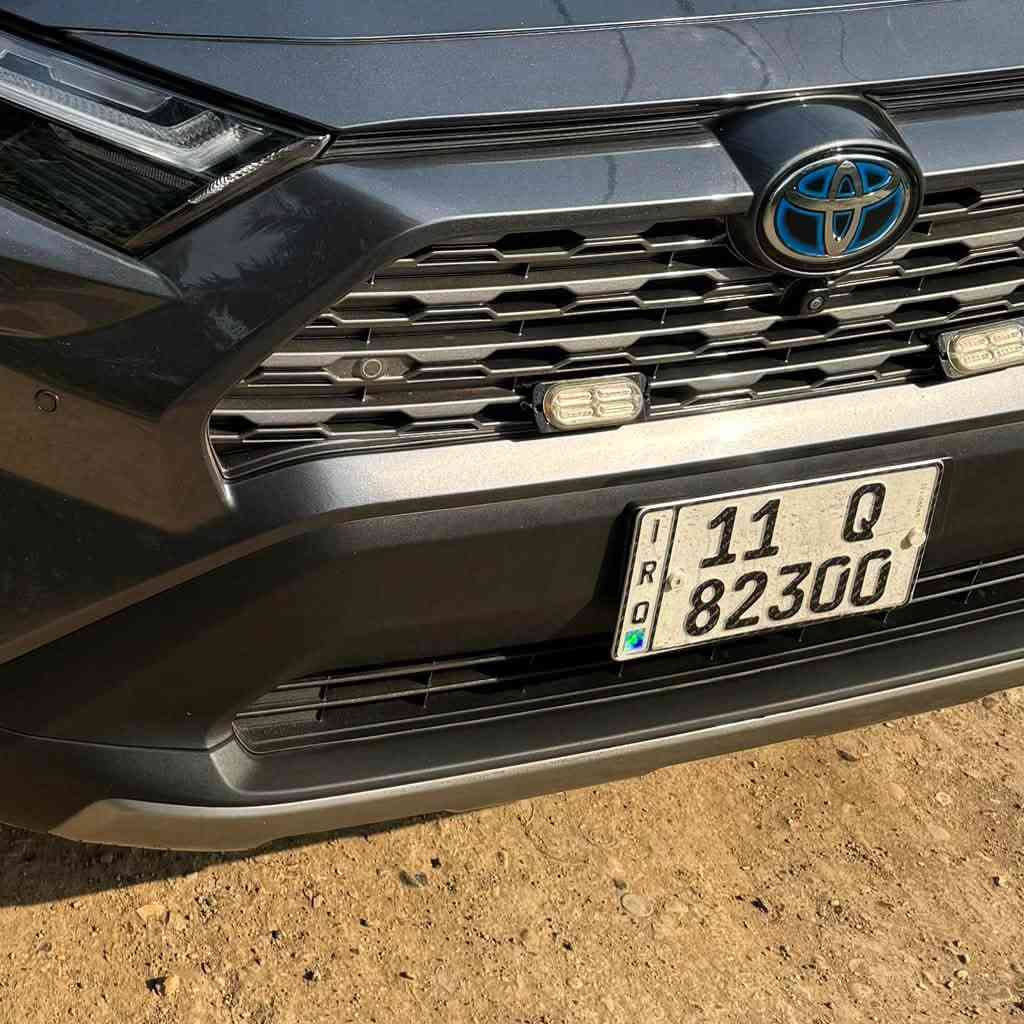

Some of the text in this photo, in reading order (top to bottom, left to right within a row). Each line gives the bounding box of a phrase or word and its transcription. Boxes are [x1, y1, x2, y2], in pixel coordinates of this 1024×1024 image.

[699, 498, 781, 569] 11
[840, 482, 886, 543] Q
[683, 548, 892, 637] 82300
